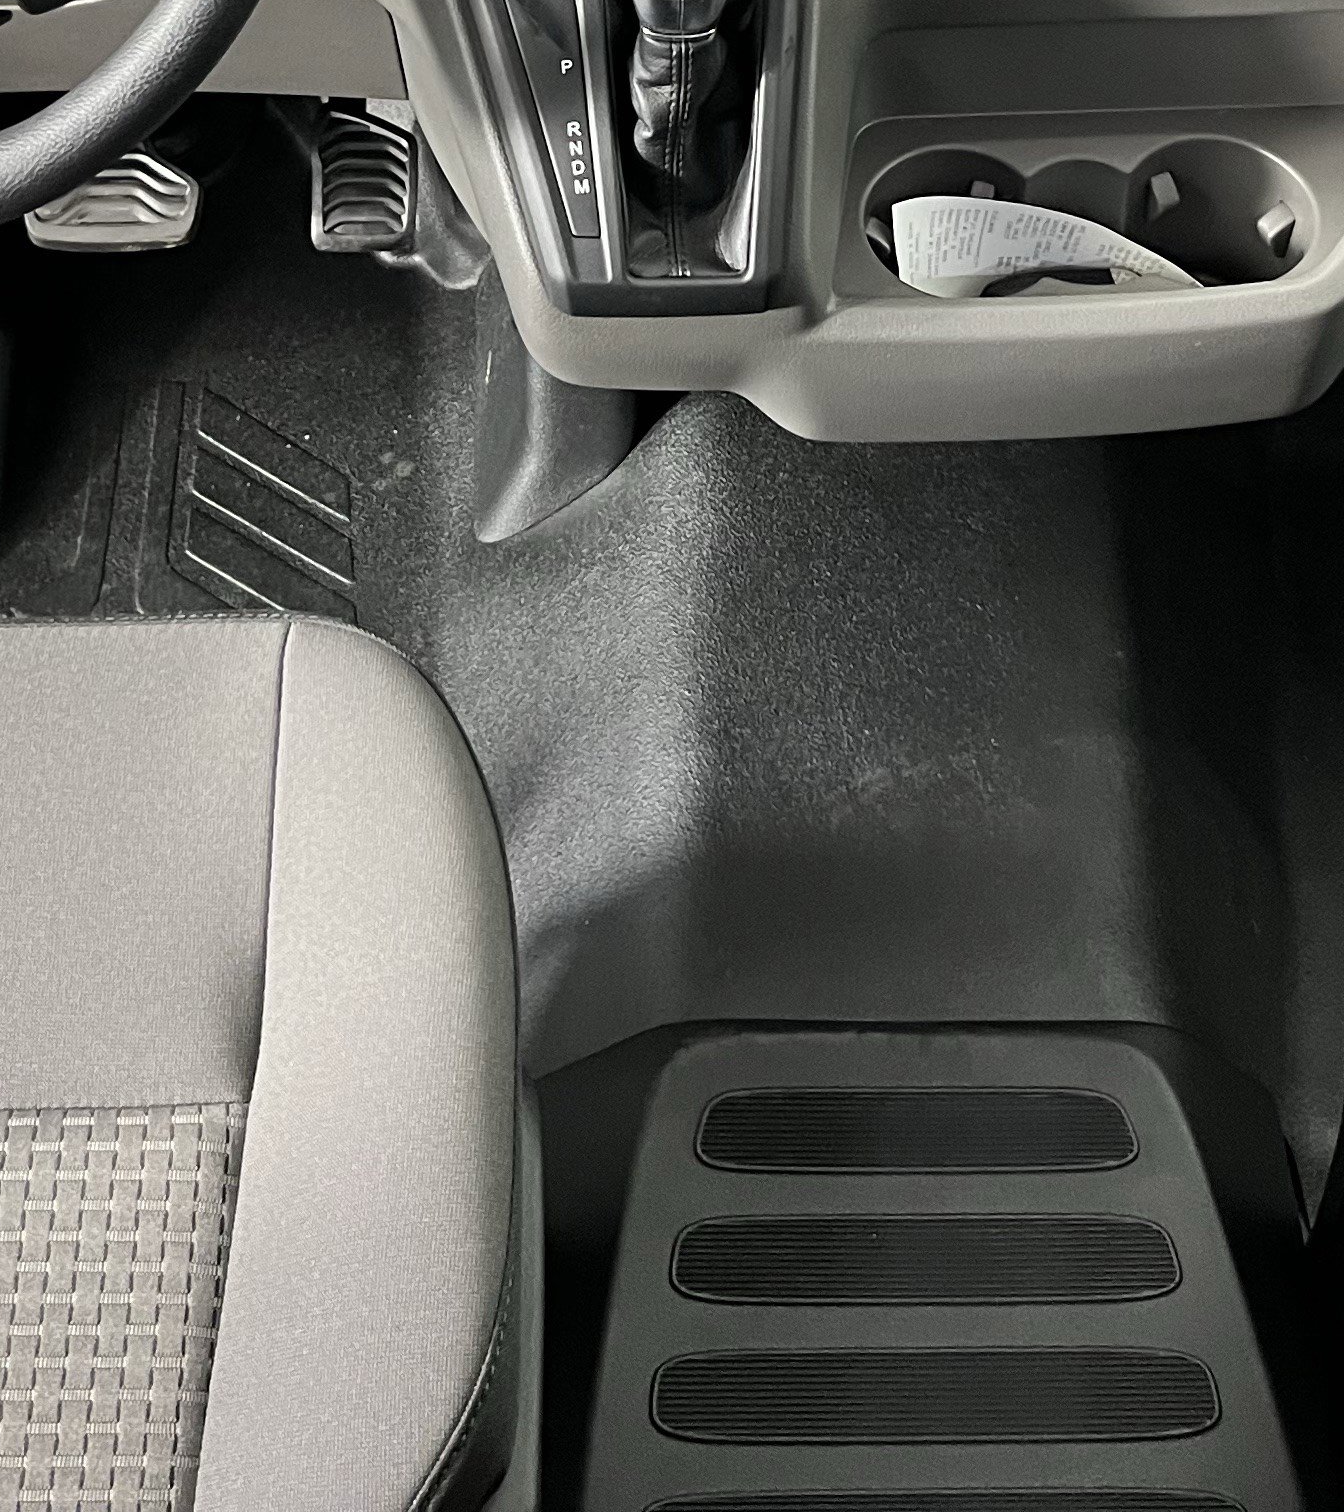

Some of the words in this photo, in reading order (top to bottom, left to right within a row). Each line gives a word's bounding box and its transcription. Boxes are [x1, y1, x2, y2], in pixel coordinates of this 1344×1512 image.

[560, 59, 573, 75] P
[566, 121, 582, 137] R
[568, 140, 584, 157] N
[571, 159, 587, 176] D
[573, 178, 591, 195] M
